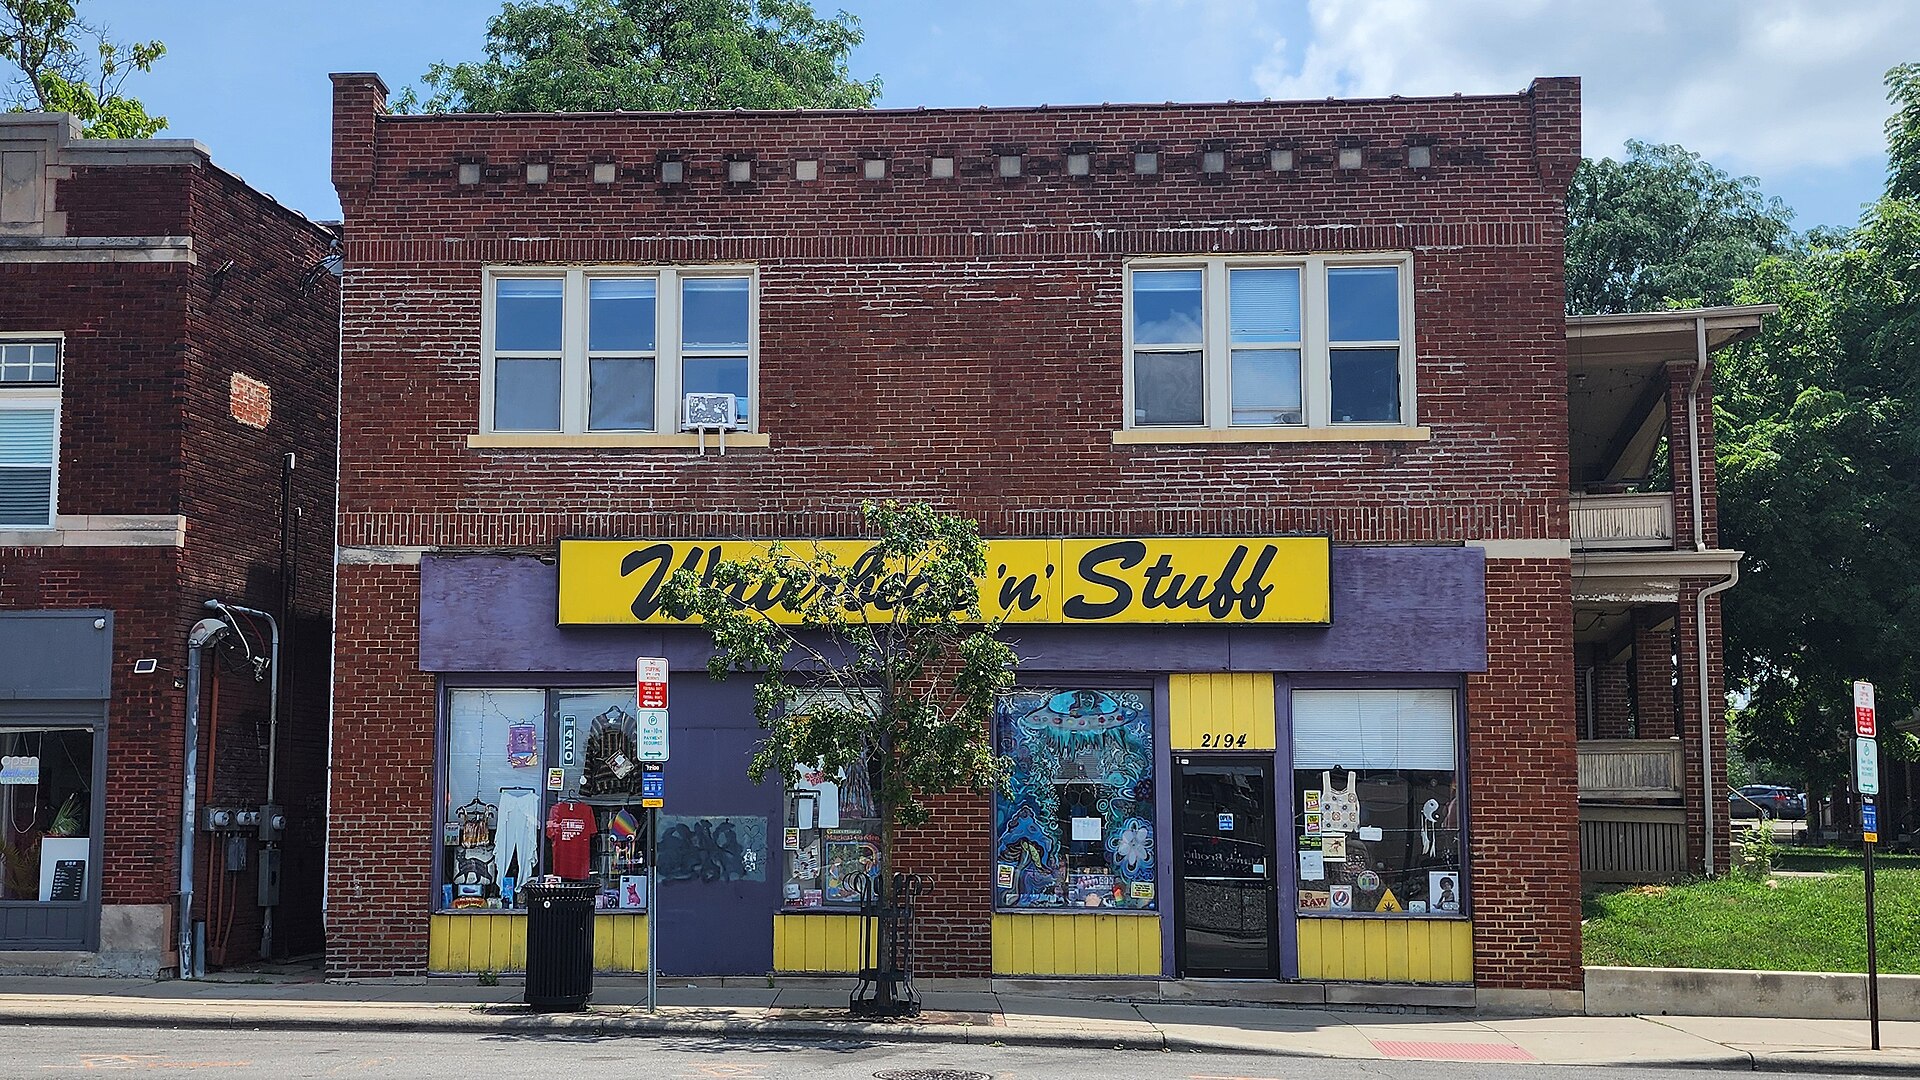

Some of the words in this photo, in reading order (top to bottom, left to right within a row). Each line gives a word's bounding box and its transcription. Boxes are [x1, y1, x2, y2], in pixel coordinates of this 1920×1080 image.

[621, 543, 977, 622] Watrbe
[1063, 540, 1279, 621] Stuff
[1201, 733, 1248, 748] 2194
[1300, 898, 1328, 908] RAW
